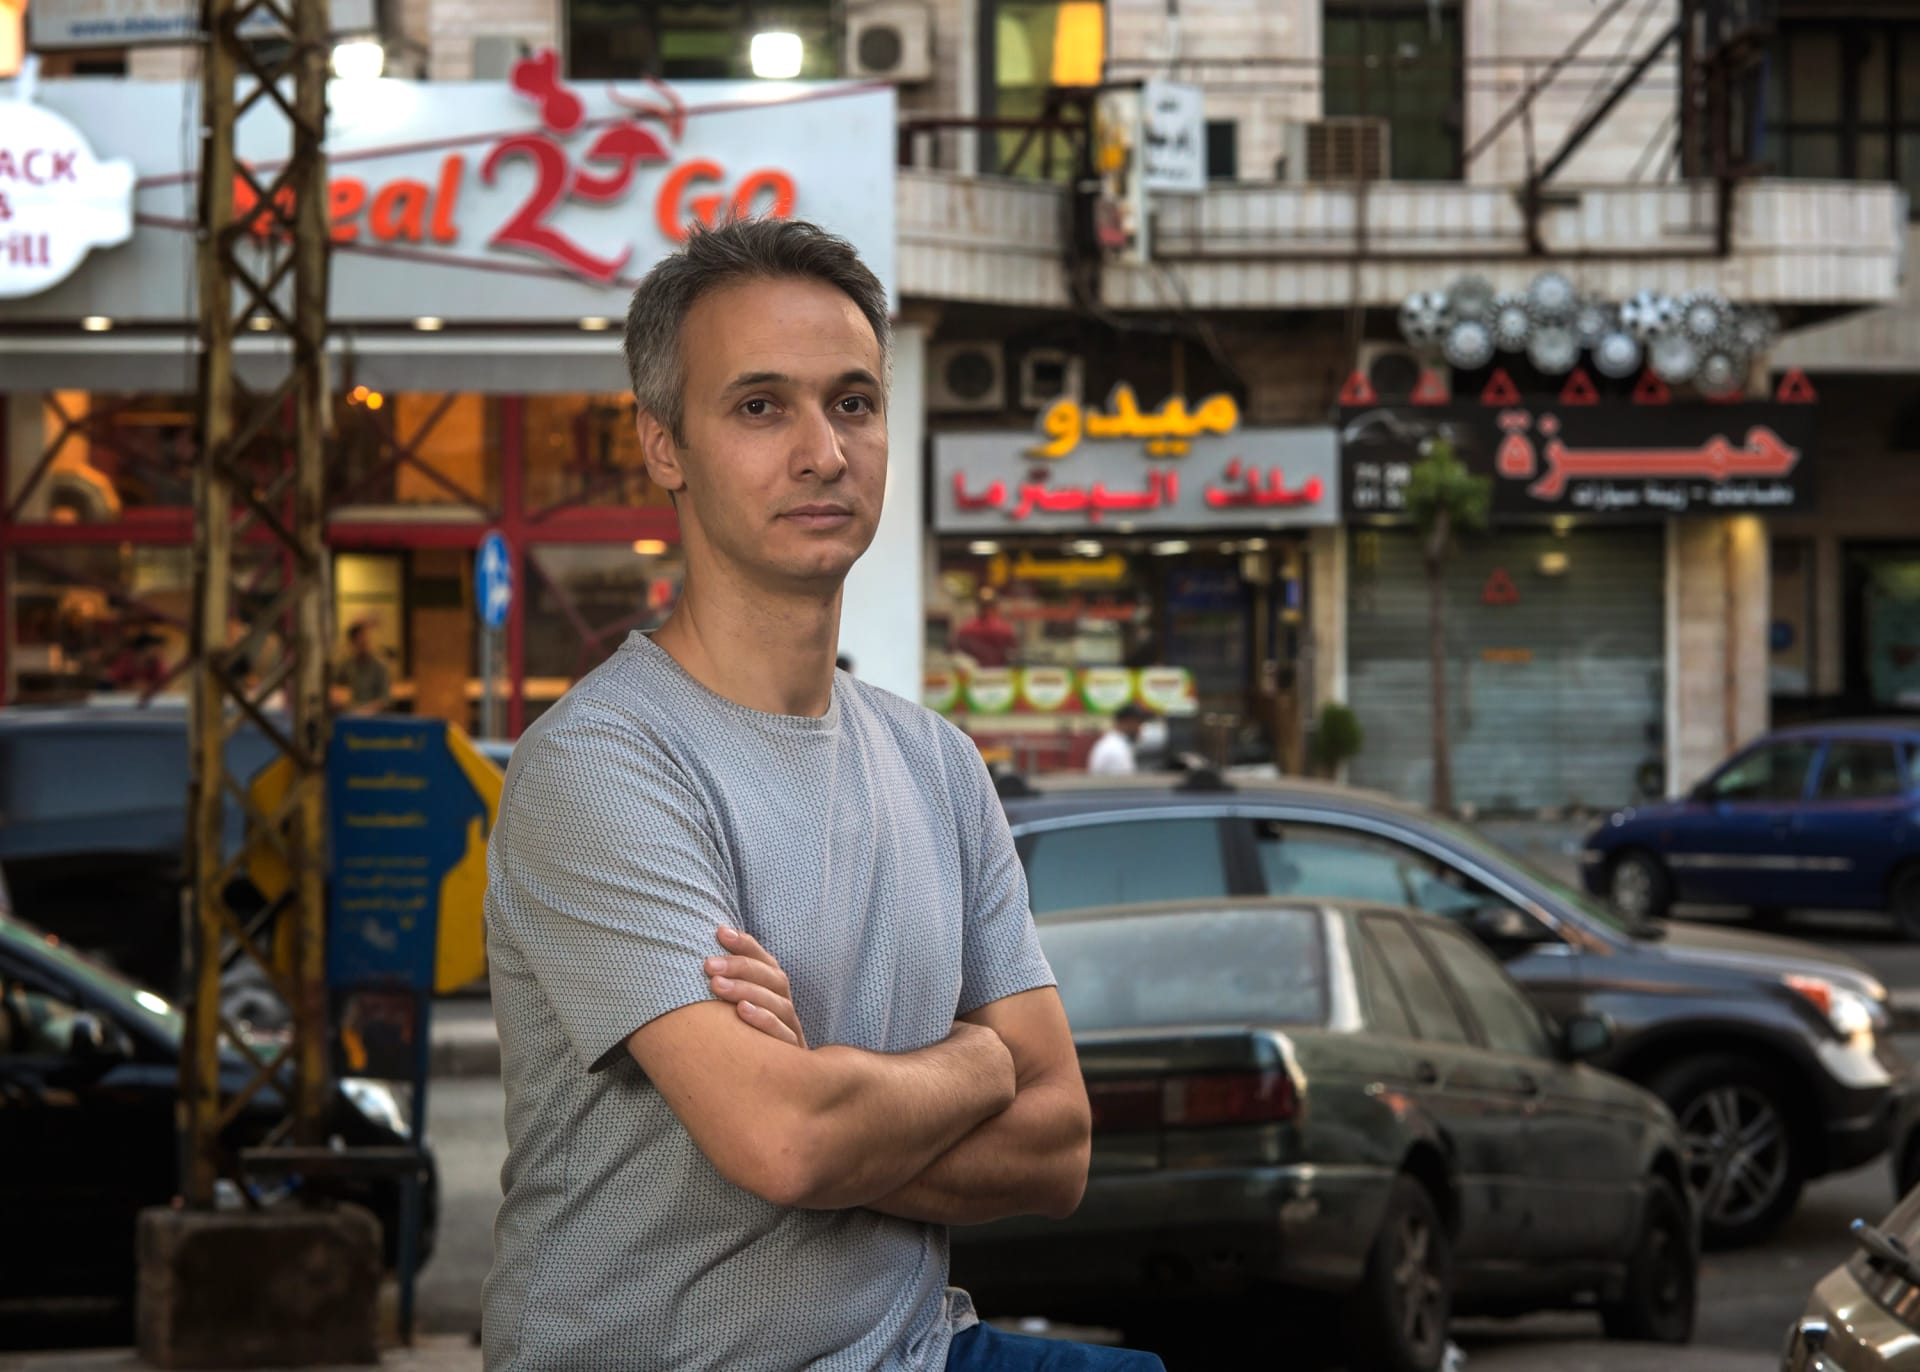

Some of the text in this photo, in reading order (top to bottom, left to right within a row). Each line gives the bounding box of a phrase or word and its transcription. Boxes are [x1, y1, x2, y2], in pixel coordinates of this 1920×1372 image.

[1024, 385, 1239, 458] ميدو
[1496, 410, 1798, 500] حمزة
[1205, 459, 1323, 507] ملك
